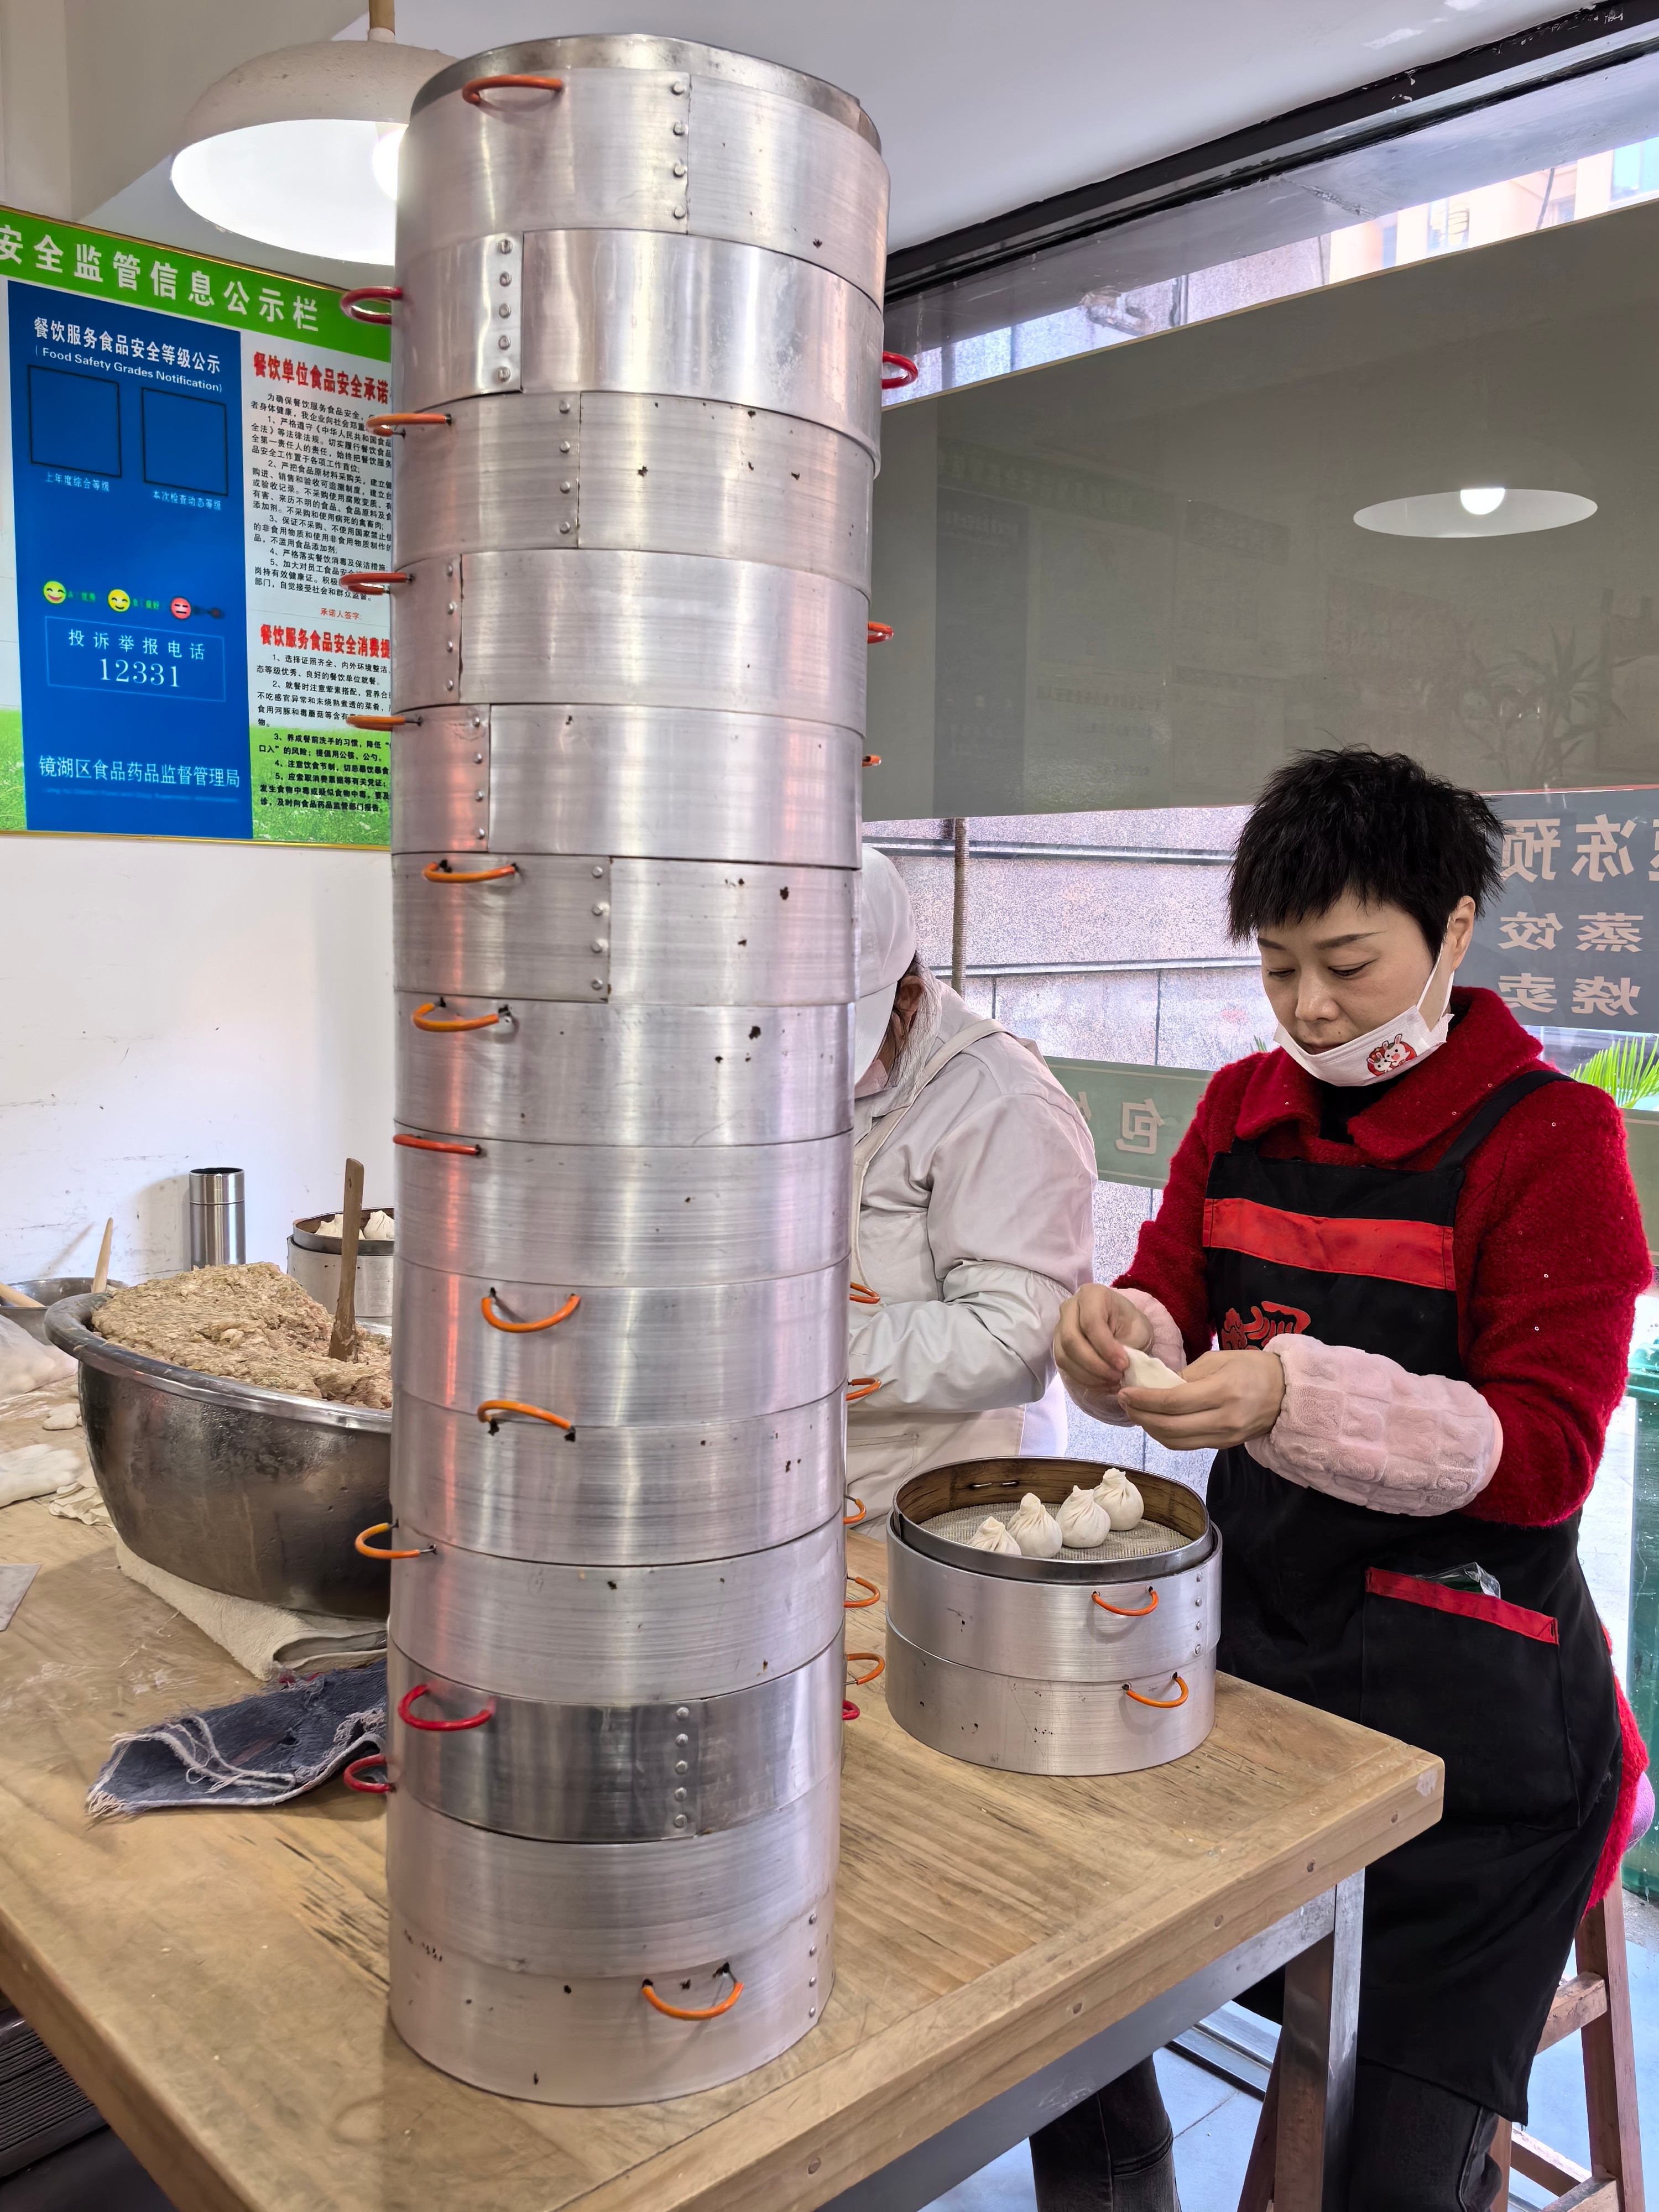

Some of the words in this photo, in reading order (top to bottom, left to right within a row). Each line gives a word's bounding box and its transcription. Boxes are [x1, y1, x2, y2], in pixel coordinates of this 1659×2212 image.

[0, 224, 319, 332] 安全监管信息公示栏
[34, 317, 220, 374] 餐饮服务食品安全等级公示
[75, 354, 111, 371] Safety
[113, 363, 154, 378] Grades
[253, 352, 391, 404] 餐饮单位食品安全承诺
[251, 400, 368, 431] 者身体健康，我企业向社会郑重
[268, 393, 377, 421] 为确保餐饮服务食品安全，
[68, 628, 205, 660] 投诉举报电话
[100, 658, 180, 688] 12331
[257, 692, 390, 712] 不吃感官异常和未烧熟煮透的菜肴，
[273, 681, 390, 699] 2、就餐时注意荤素搭配，营养合
[274, 733, 390, 749] 3、养成餐前洗手的习惯，降低“
[39, 755, 239, 787] 镜湖区食品药品监督管理局
